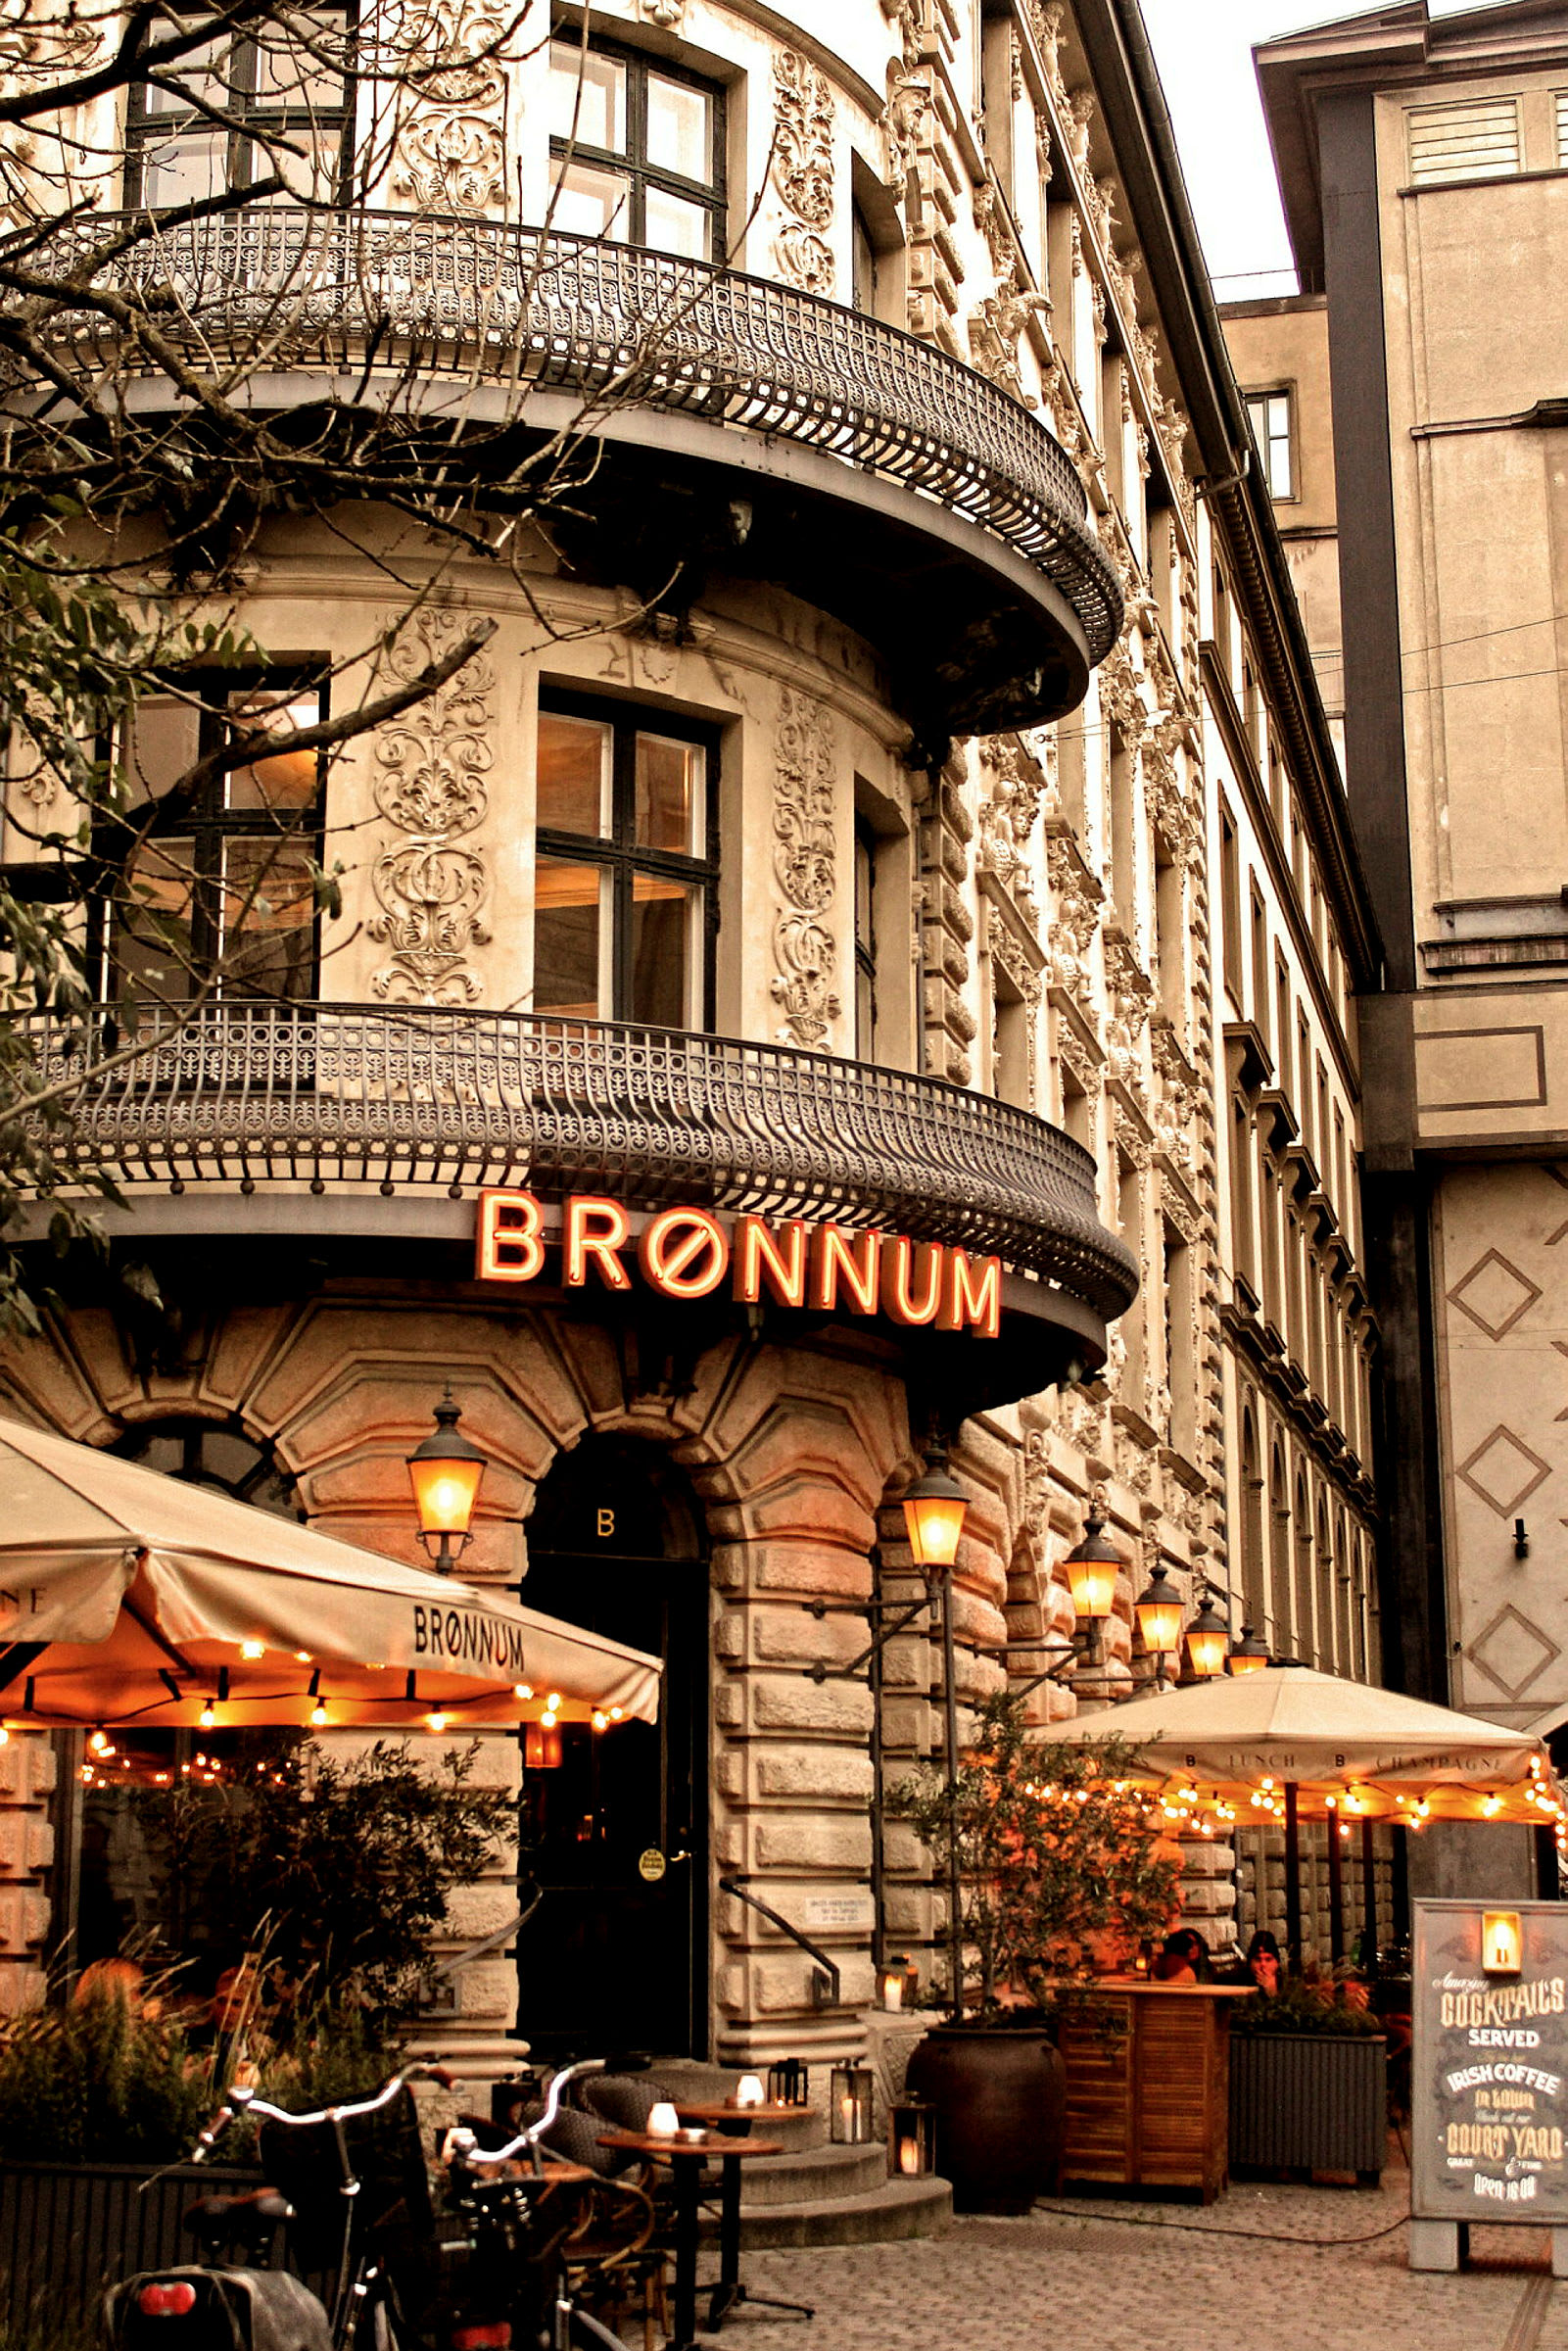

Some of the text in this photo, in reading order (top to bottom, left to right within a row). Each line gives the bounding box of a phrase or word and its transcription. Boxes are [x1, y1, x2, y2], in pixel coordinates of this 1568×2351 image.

[476, 1188, 1000, 1338] BRØNNUM
[596, 1508, 615, 1537] B
[413, 1605, 525, 1672] BRØNNUM
[1185, 1753, 1196, 1768] B
[1335, 1753, 1346, 1767] B
[1441, 1977, 1565, 2028] COCKTAILS
[1468, 2029, 1541, 2048] SERVED
[1447, 2063, 1561, 2096] IRISH COFFEE
[1447, 2122, 1564, 2161] COURT YARD
